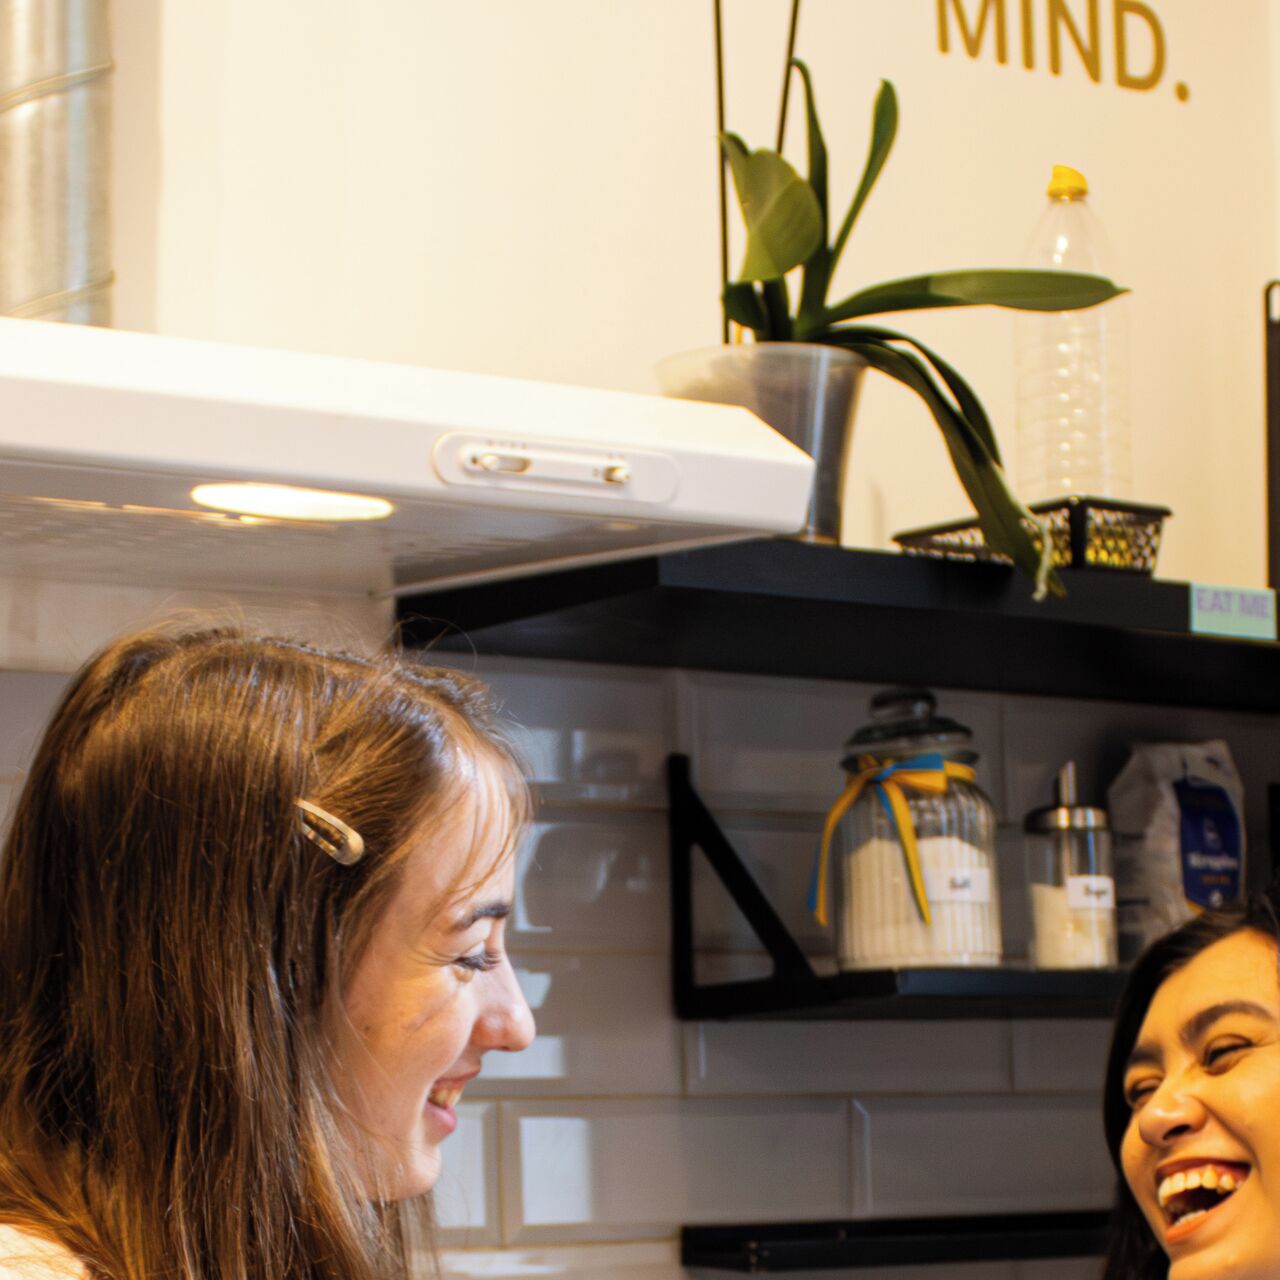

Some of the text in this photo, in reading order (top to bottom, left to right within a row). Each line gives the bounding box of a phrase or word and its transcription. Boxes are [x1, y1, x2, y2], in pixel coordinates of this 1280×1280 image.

[934, 0, 1189, 103] MIND.
[1197, 588, 1271, 619] EAT ME
